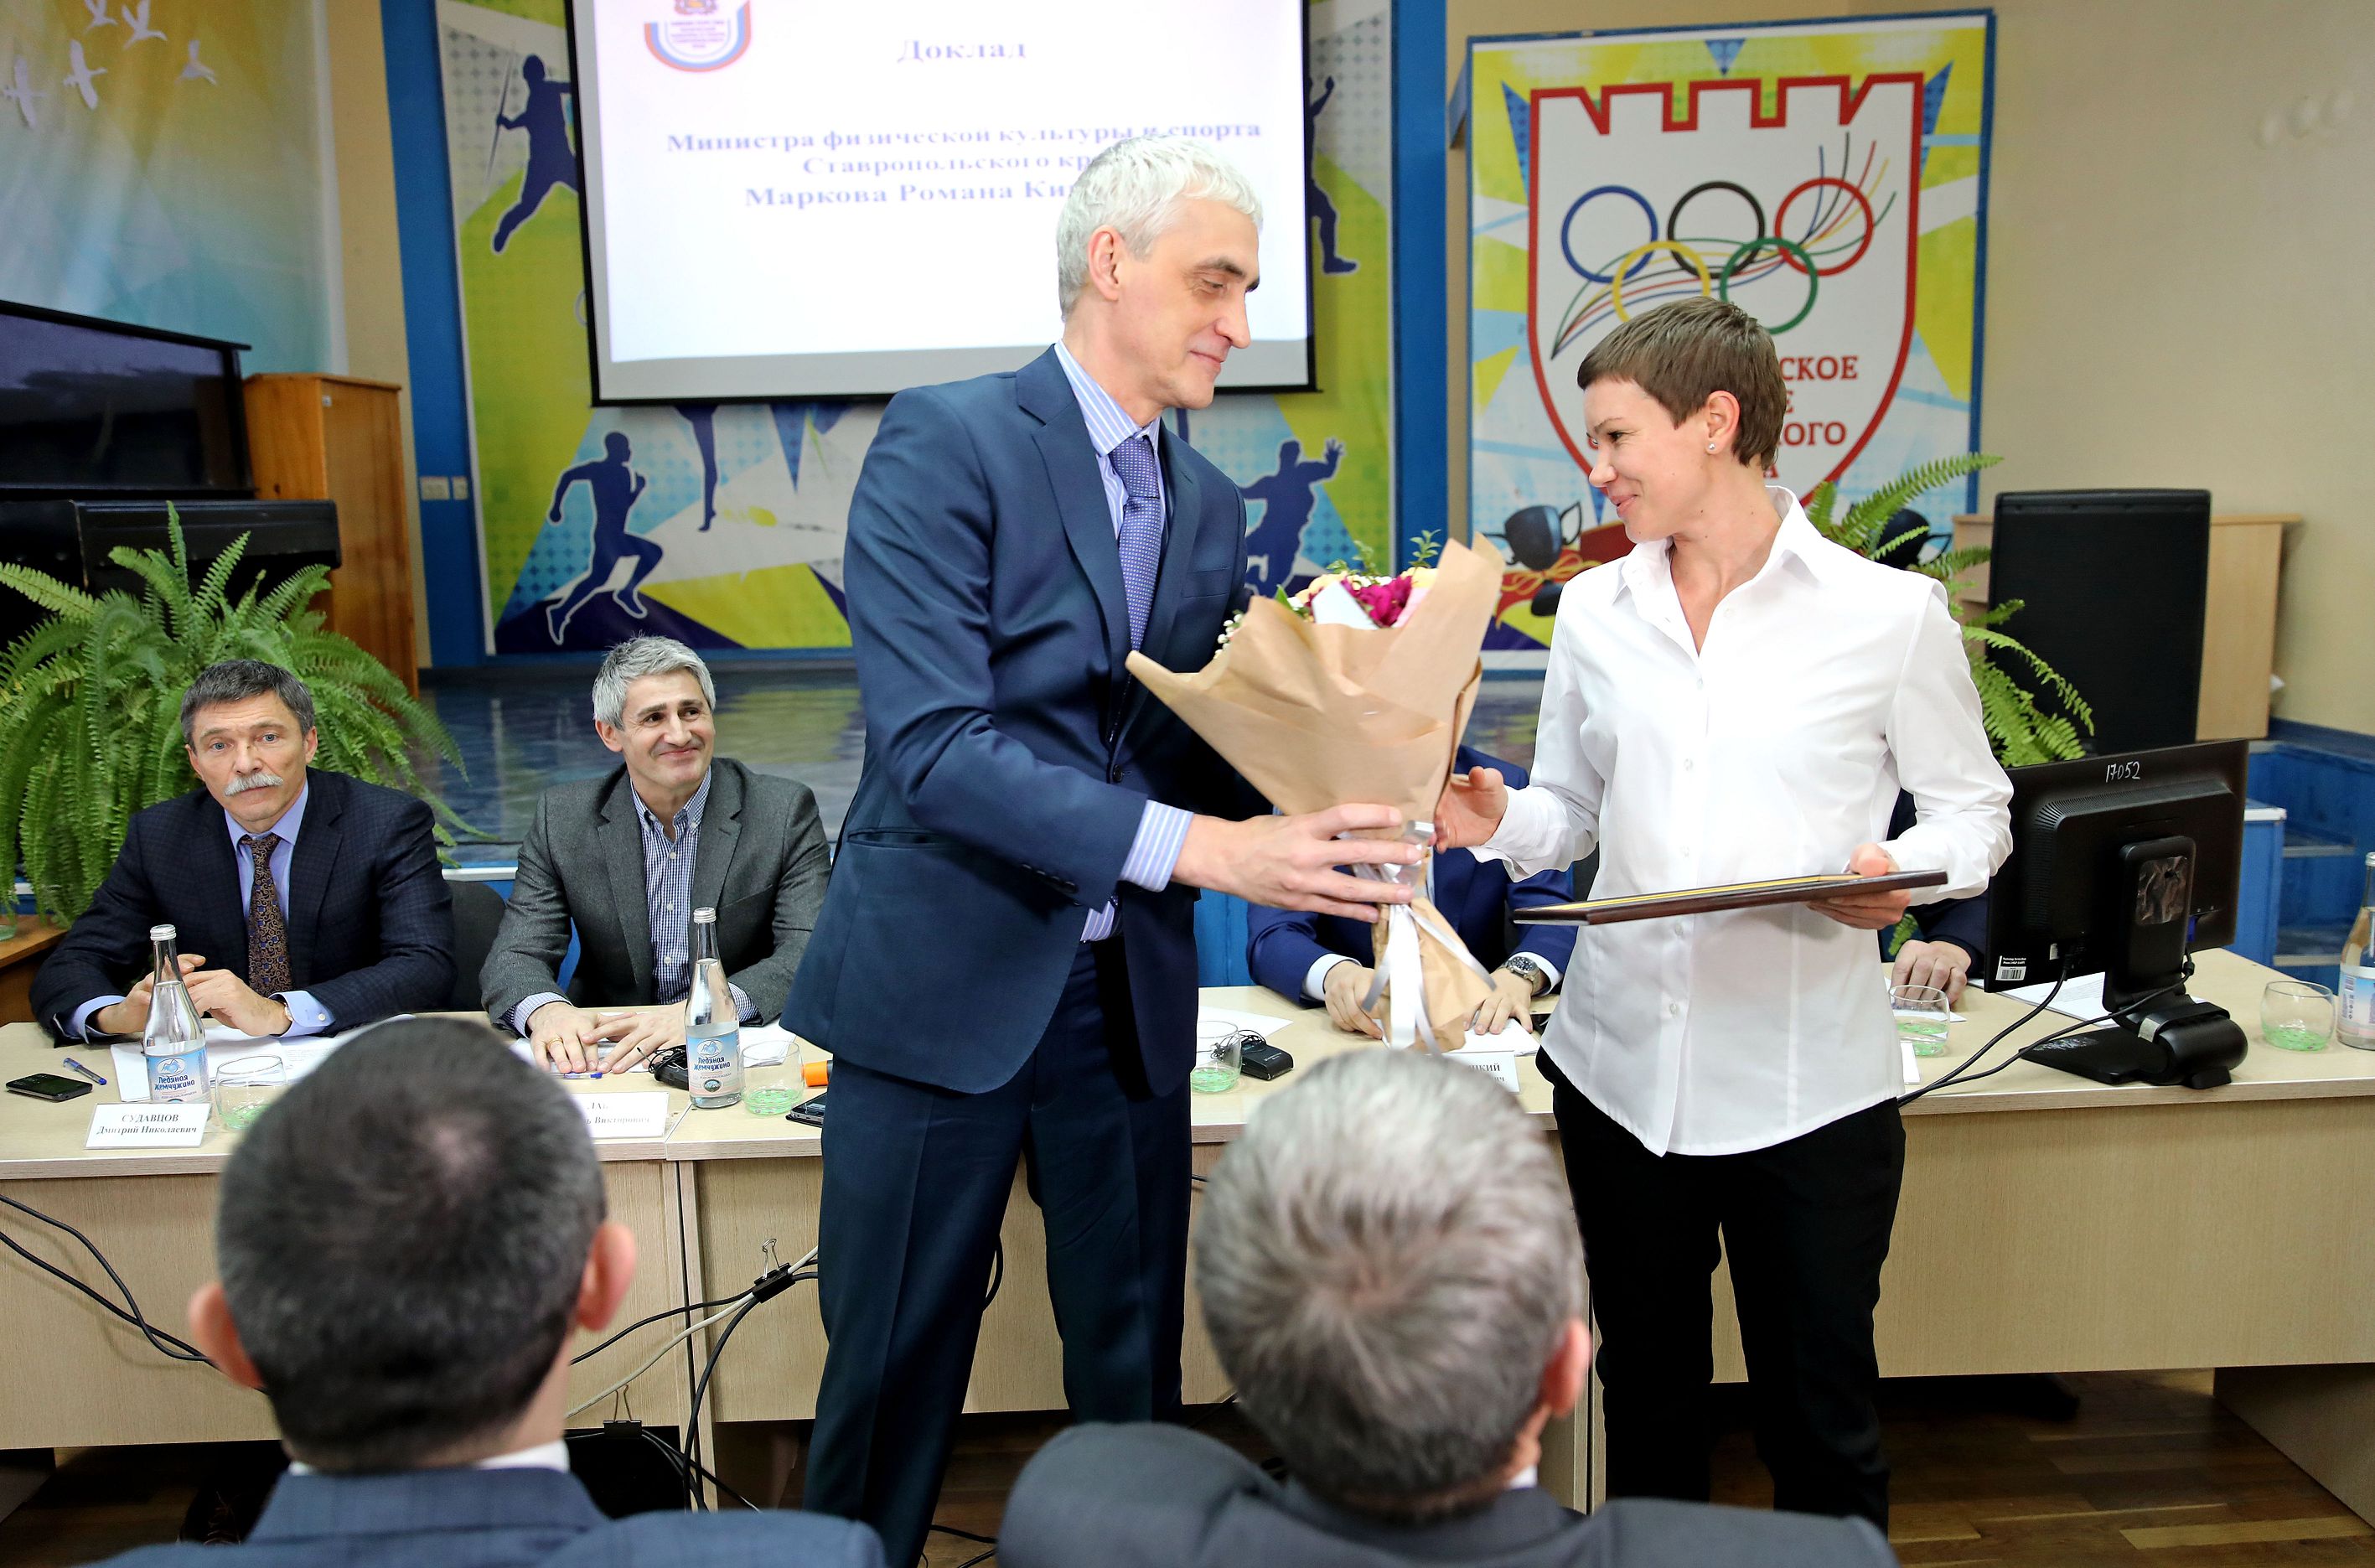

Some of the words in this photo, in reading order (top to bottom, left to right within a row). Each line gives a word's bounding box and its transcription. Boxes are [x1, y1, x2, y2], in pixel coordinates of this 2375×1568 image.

[897, 40, 1025, 63] Доклад
[667, 134, 815, 152] Министра
[823, 129, 990, 151] физической
[999, 127, 1133, 144] культуры
[1167, 124, 1261, 142] спорта
[802, 157, 1049, 176] Ставропольского
[745, 188, 887, 210] Маркова
[899, 184, 1013, 202] Романа
[2105, 761, 2141, 783] 17052
[158, 1074, 189, 1084] Ледяная
[122, 1114, 179, 1123] СУДАВЦОВ
[96, 1126, 139, 1136] Дмитрий
[141, 1126, 197, 1134] Николаевич
